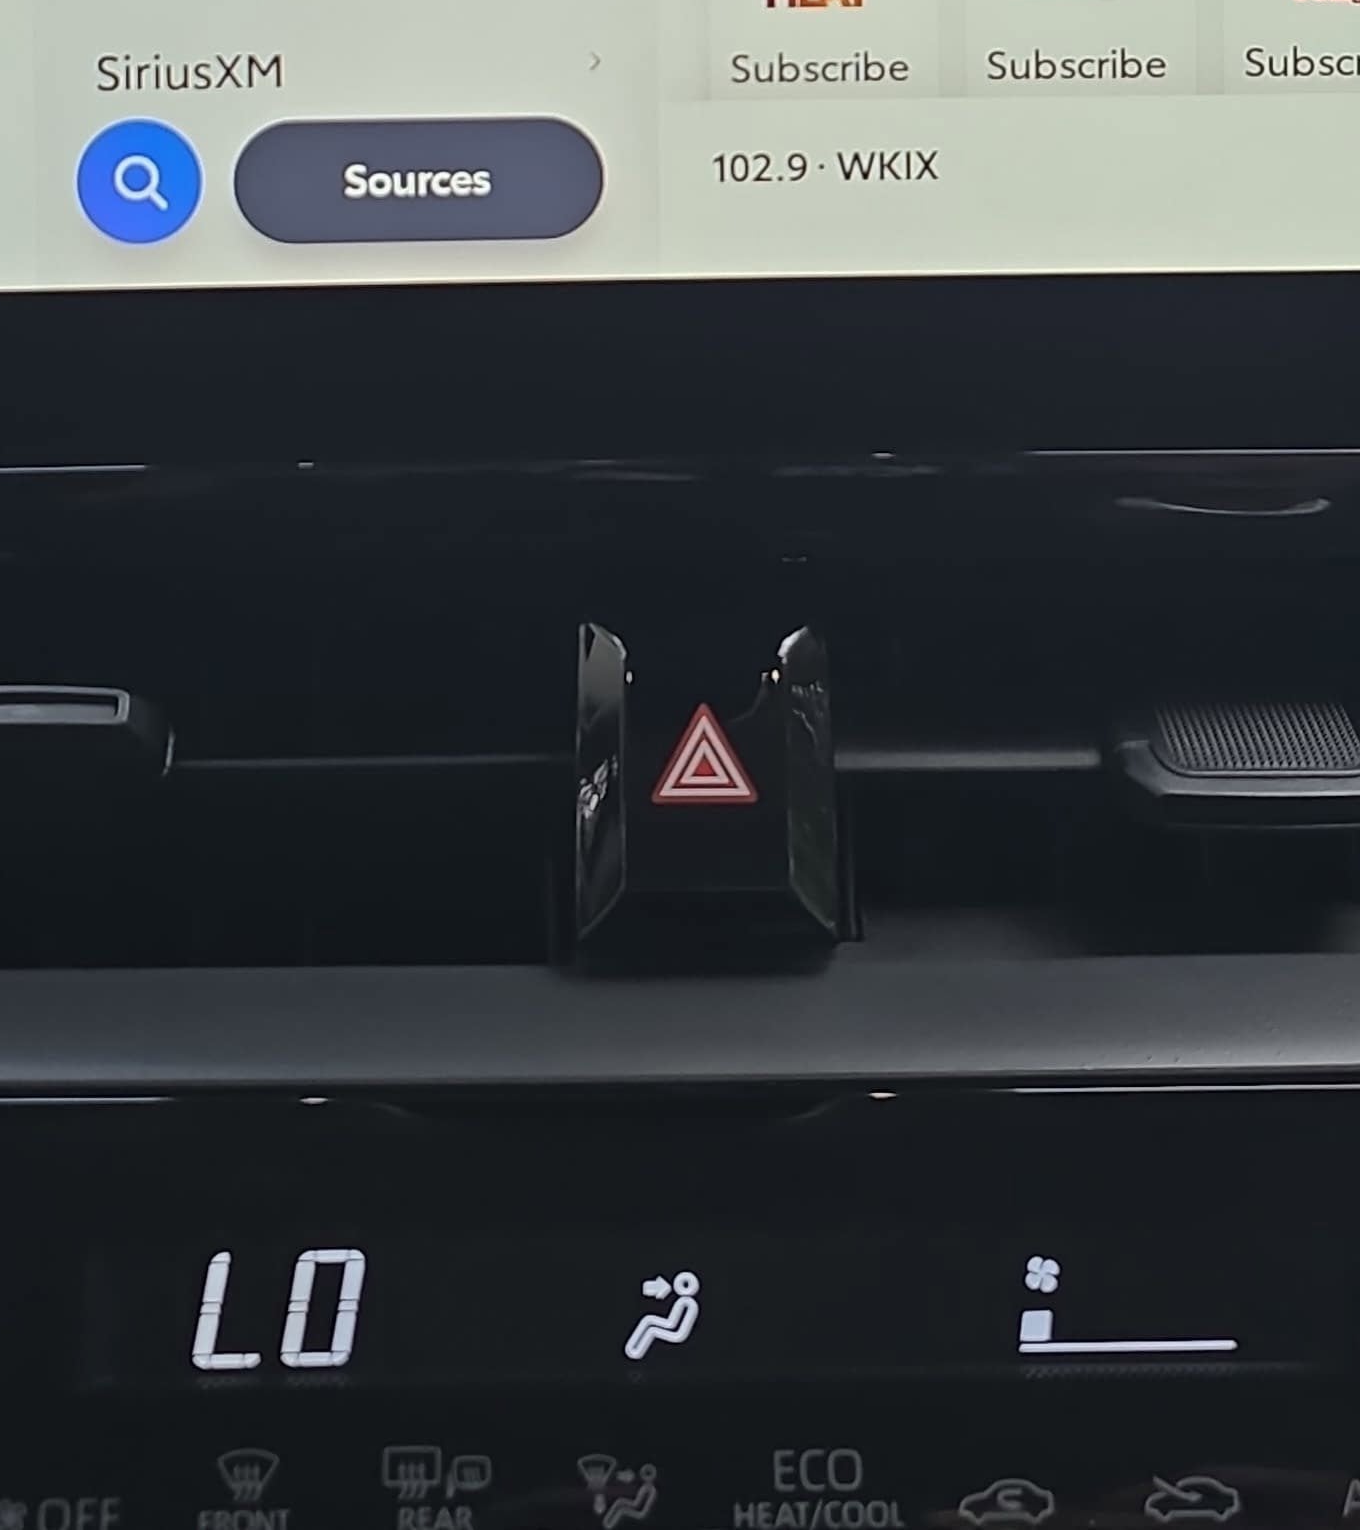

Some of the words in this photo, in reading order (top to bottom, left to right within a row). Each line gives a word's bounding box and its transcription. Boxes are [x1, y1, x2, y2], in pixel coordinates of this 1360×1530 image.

[97, 54, 282, 92] SiriusXM
[731, 51, 909, 84] Subscribe
[987, 47, 1167, 80] Subscribe
[344, 164, 491, 198] Sources
[713, 152, 808, 183] 102.9
[836, 150, 938, 181] WKIX
[773, 1448, 863, 1492] ECO
[38, 1496, 122, 1530] OFF
[198, 1509, 292, 1530] FRONT
[397, 1505, 474, 1530] REAR
[734, 1500, 903, 1530] HEAT/COOL
